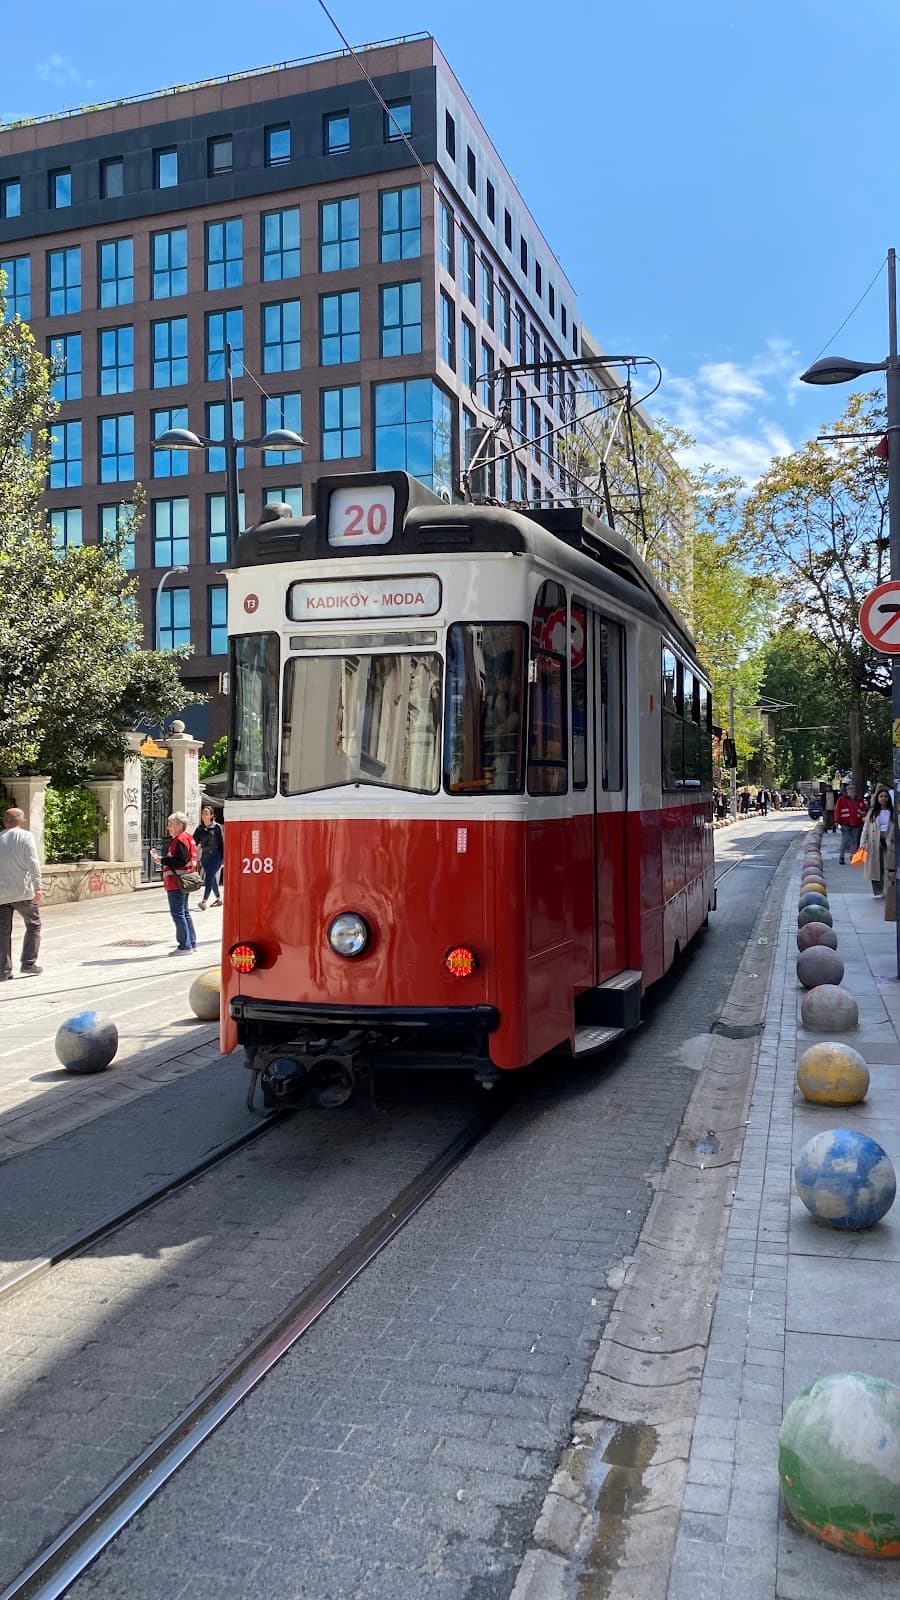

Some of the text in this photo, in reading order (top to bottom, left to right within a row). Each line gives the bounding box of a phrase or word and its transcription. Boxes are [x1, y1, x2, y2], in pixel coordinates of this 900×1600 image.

[343, 503, 387, 537] 20
[246, 599, 256, 609] T3
[306, 593, 369, 609] KADIKÖY
[382, 592, 425, 606] MODA
[242, 857, 274, 874] 208
